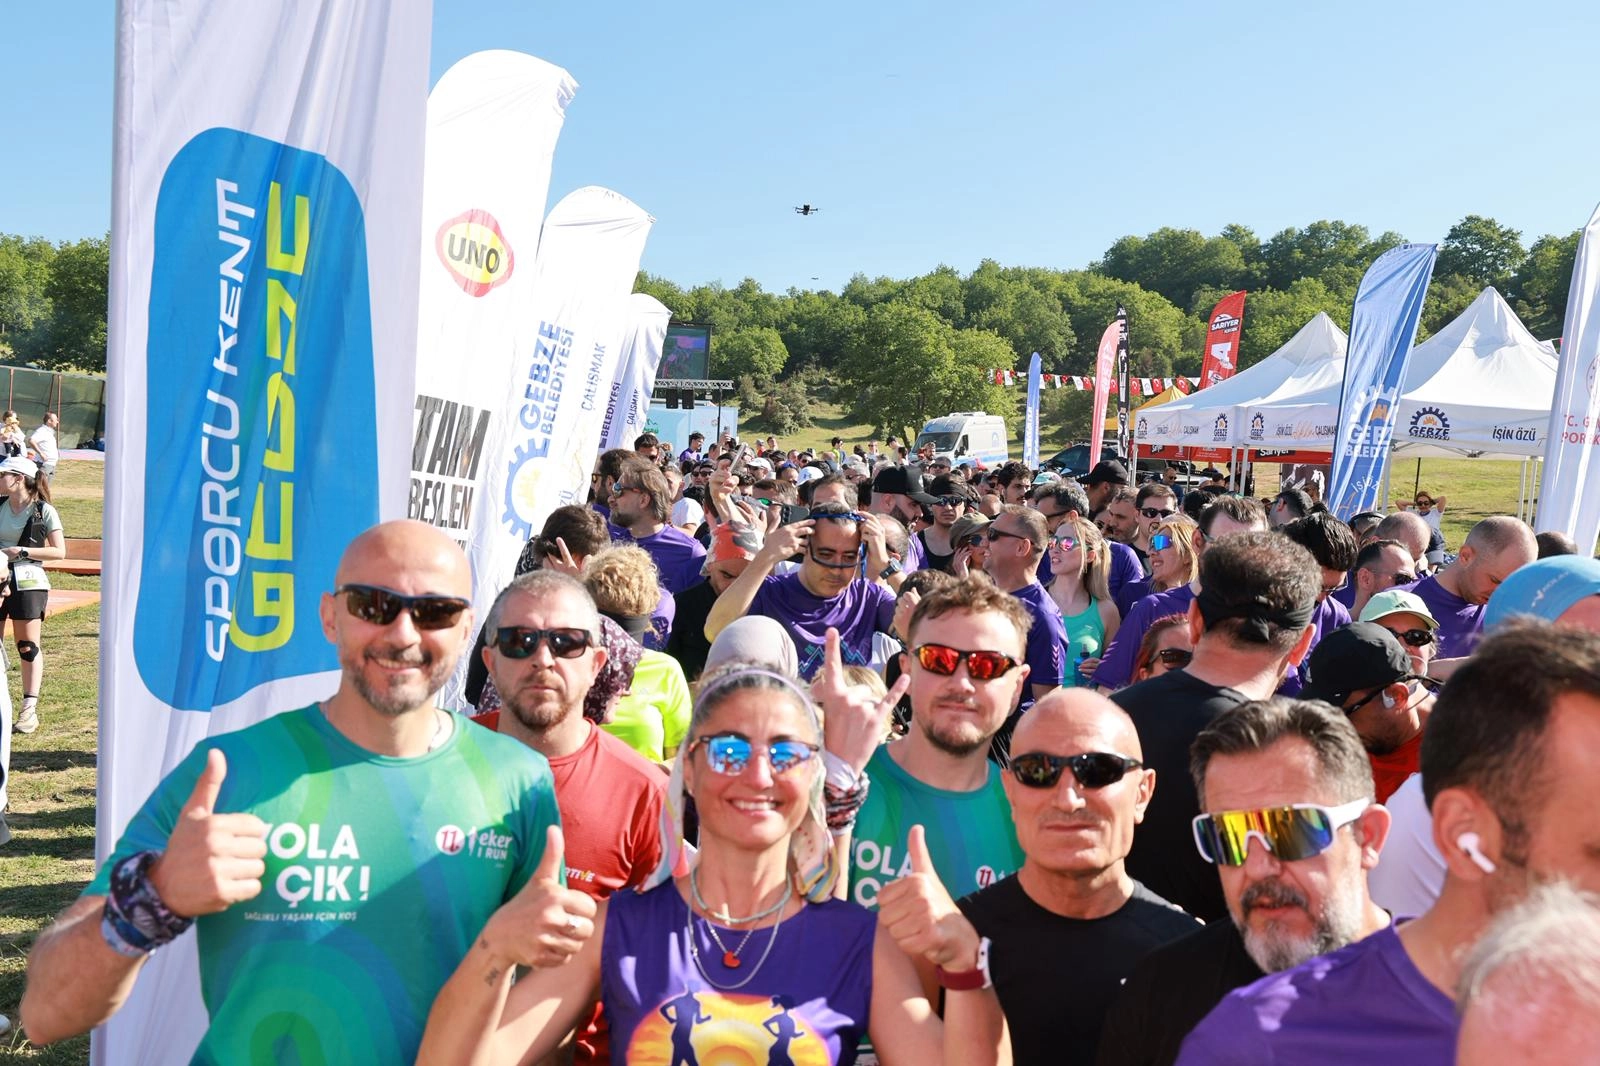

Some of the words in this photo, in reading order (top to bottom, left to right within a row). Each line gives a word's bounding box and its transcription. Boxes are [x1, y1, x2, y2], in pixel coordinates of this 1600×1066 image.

[447, 233, 501, 274] UNO
[212, 177, 255, 376] KENT
[519, 320, 562, 430] GEBZE
[540, 328, 575, 435] BELEDİYESİ
[411, 394, 492, 481] TAM
[1408, 425, 1451, 437] GEBZE
[1492, 426, 1514, 441] İŞİN
[1515, 427, 1537, 441] ÖZÜ
[407, 477, 474, 530] BESLEN
[479, 828, 513, 849] eker
[485, 847, 508, 860] RUN
[275, 864, 371, 909] ÇIK!
